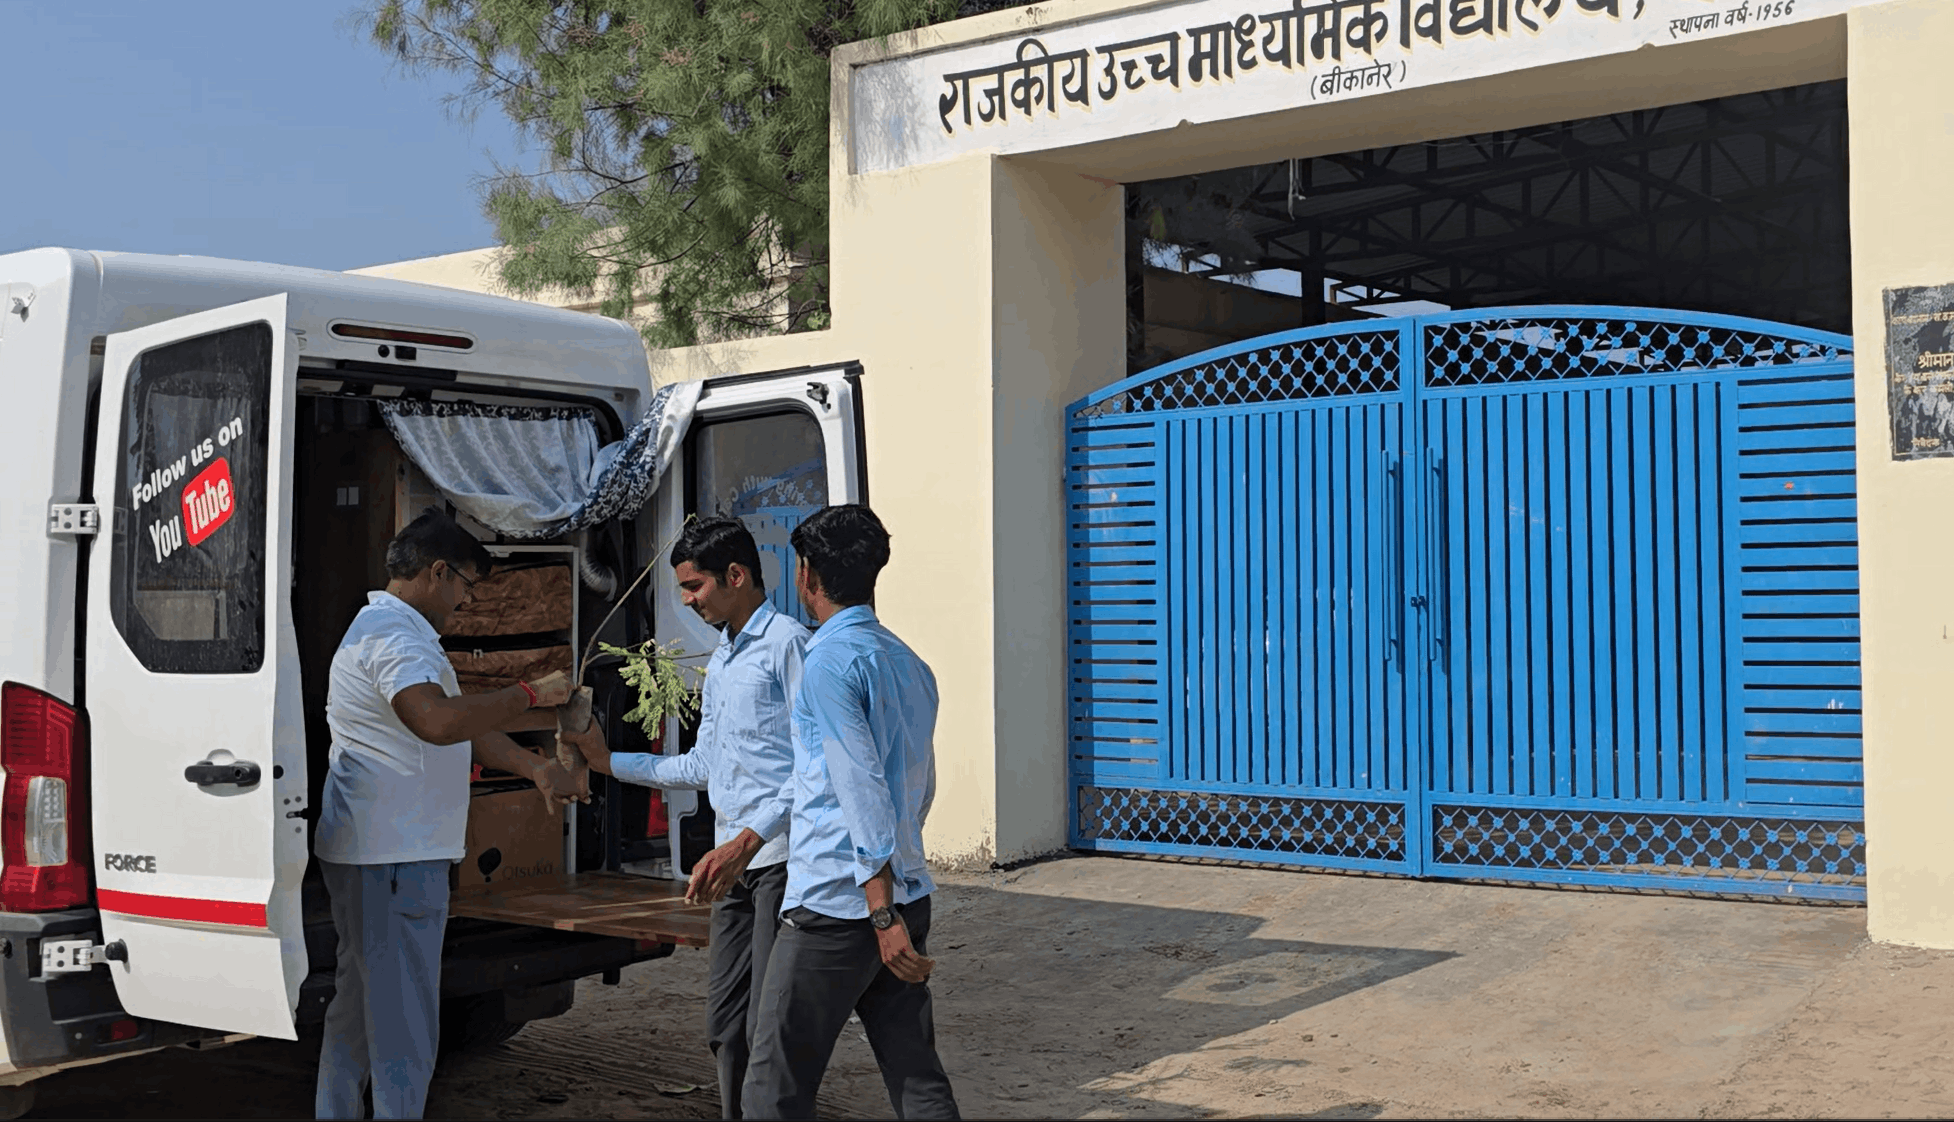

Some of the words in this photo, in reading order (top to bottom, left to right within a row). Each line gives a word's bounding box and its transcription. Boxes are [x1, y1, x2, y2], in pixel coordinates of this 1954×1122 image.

[939, 38, 1090, 134] राजकीय
[1095, 30, 1180, 100] उच्च
[1186, 0, 1389, 83] माध्यमिक
[1669, 12, 1720, 39] स्थापना
[132, 455, 187, 512] Follow
[190, 437, 214, 467] us
[218, 416, 243, 446] on
[149, 515, 182, 564] You
[184, 478, 231, 535] Tube
[104, 853, 157, 874] FORCE
